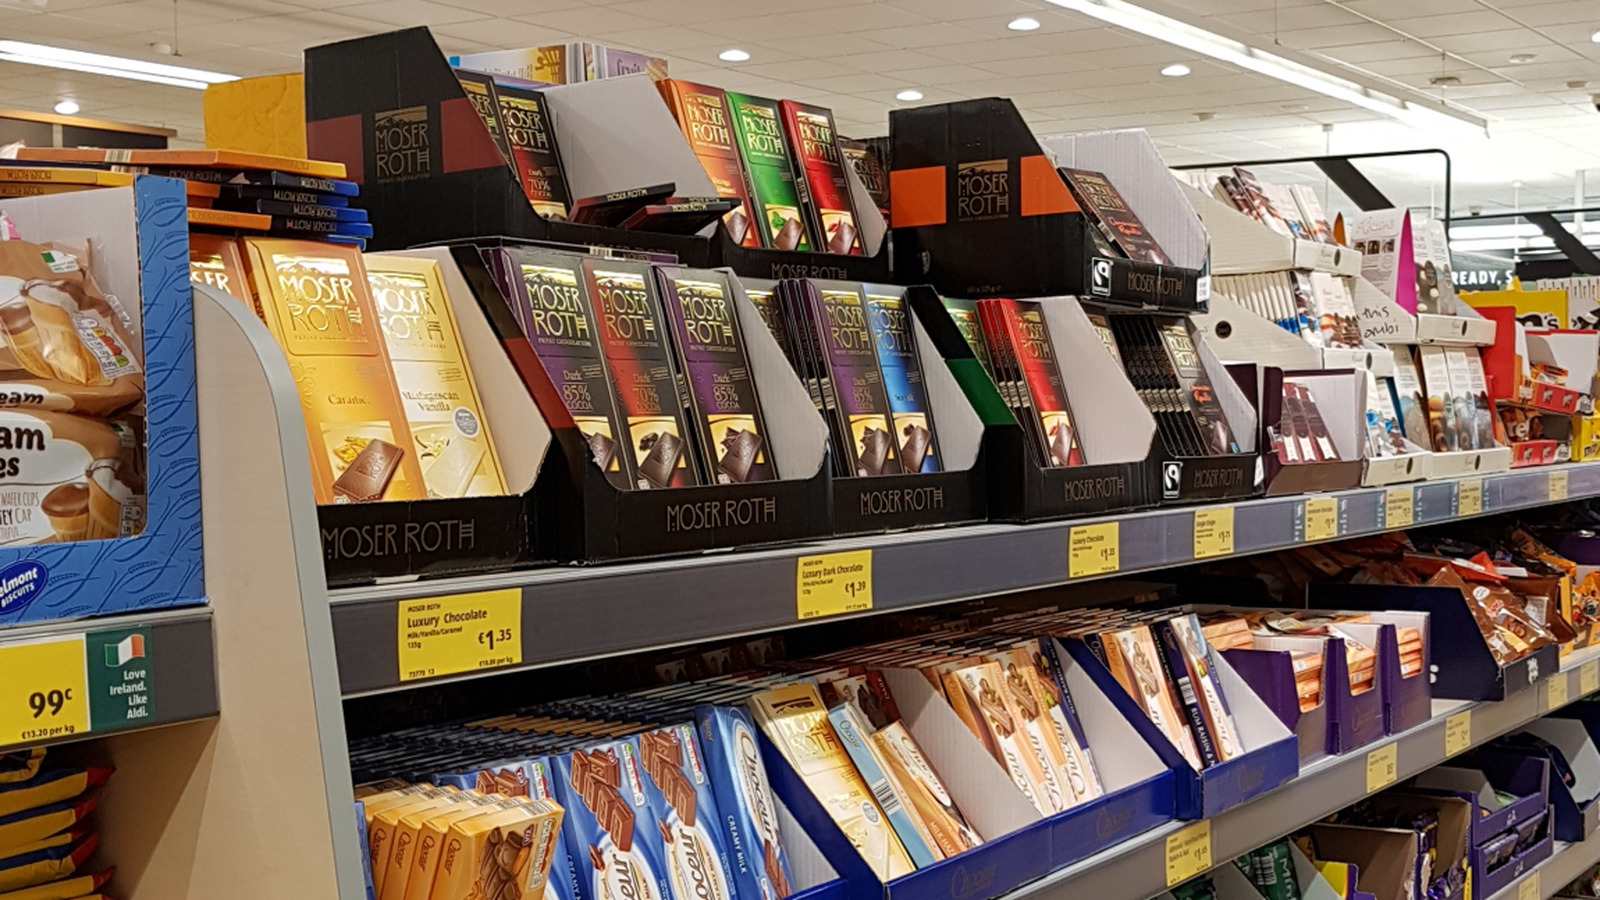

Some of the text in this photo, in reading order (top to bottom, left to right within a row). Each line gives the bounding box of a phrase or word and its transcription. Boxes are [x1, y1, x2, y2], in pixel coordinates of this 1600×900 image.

[687, 106, 725, 127] MOSER
[742, 116, 780, 138] MOSER
[375, 123, 428, 153] MOSER
[692, 123, 730, 145] ROTH
[747, 133, 784, 155] ROTH
[799, 123, 832, 144] MOSER
[804, 140, 838, 162] ROTH
[377, 148, 430, 178] ROTH
[958, 173, 1008, 197] MOSER
[958, 193, 1009, 217] ROTH
[278, 273, 353, 304] MOSER
[1451, 270, 1502, 286] READY,
[372, 288, 436, 316] MOSER
[525, 282, 584, 313] MOSER
[598, 289, 652, 315] MOSER
[678, 295, 731, 321] MOSER
[286, 303, 365, 334] ROTH
[532, 310, 590, 338] ROTH
[604, 314, 658, 340] ROTH
[826, 305, 866, 327] MOSER
[684, 320, 736, 346] ROTH
[831, 327, 871, 349] ROTH
[562, 385, 591, 400] 85%
[632, 388, 659, 402] 70%
[713, 386, 738, 401] 85%
[1064, 475, 1125, 502] MOSER ROTH
[860, 486, 944, 516] MOSER ROTH
[666, 497, 776, 532] MOSER ROTH
[321, 518, 475, 560] MOSER ROTH
[823, 566, 836, 577] Dark
[837, 563, 864, 575] Chocolate
[407, 609, 488, 628] Luxury Chocolate
[478, 628, 512, 650] €1.35
[123, 669, 147, 680] Love
[109, 682, 147, 696] Ireland.
[128, 694, 148, 705] Like
[126, 706, 149, 719] Aldi.
[21, 724, 75, 739] €13.20 per kg
[1190, 706, 1201, 726] RUM
[1197, 725, 1212, 754] RAISIN
[740, 730, 776, 842] Choceur
[928, 821, 944, 840] MILK
[727, 814, 742, 846] CREAMY
[737, 848, 748, 875] MILK
